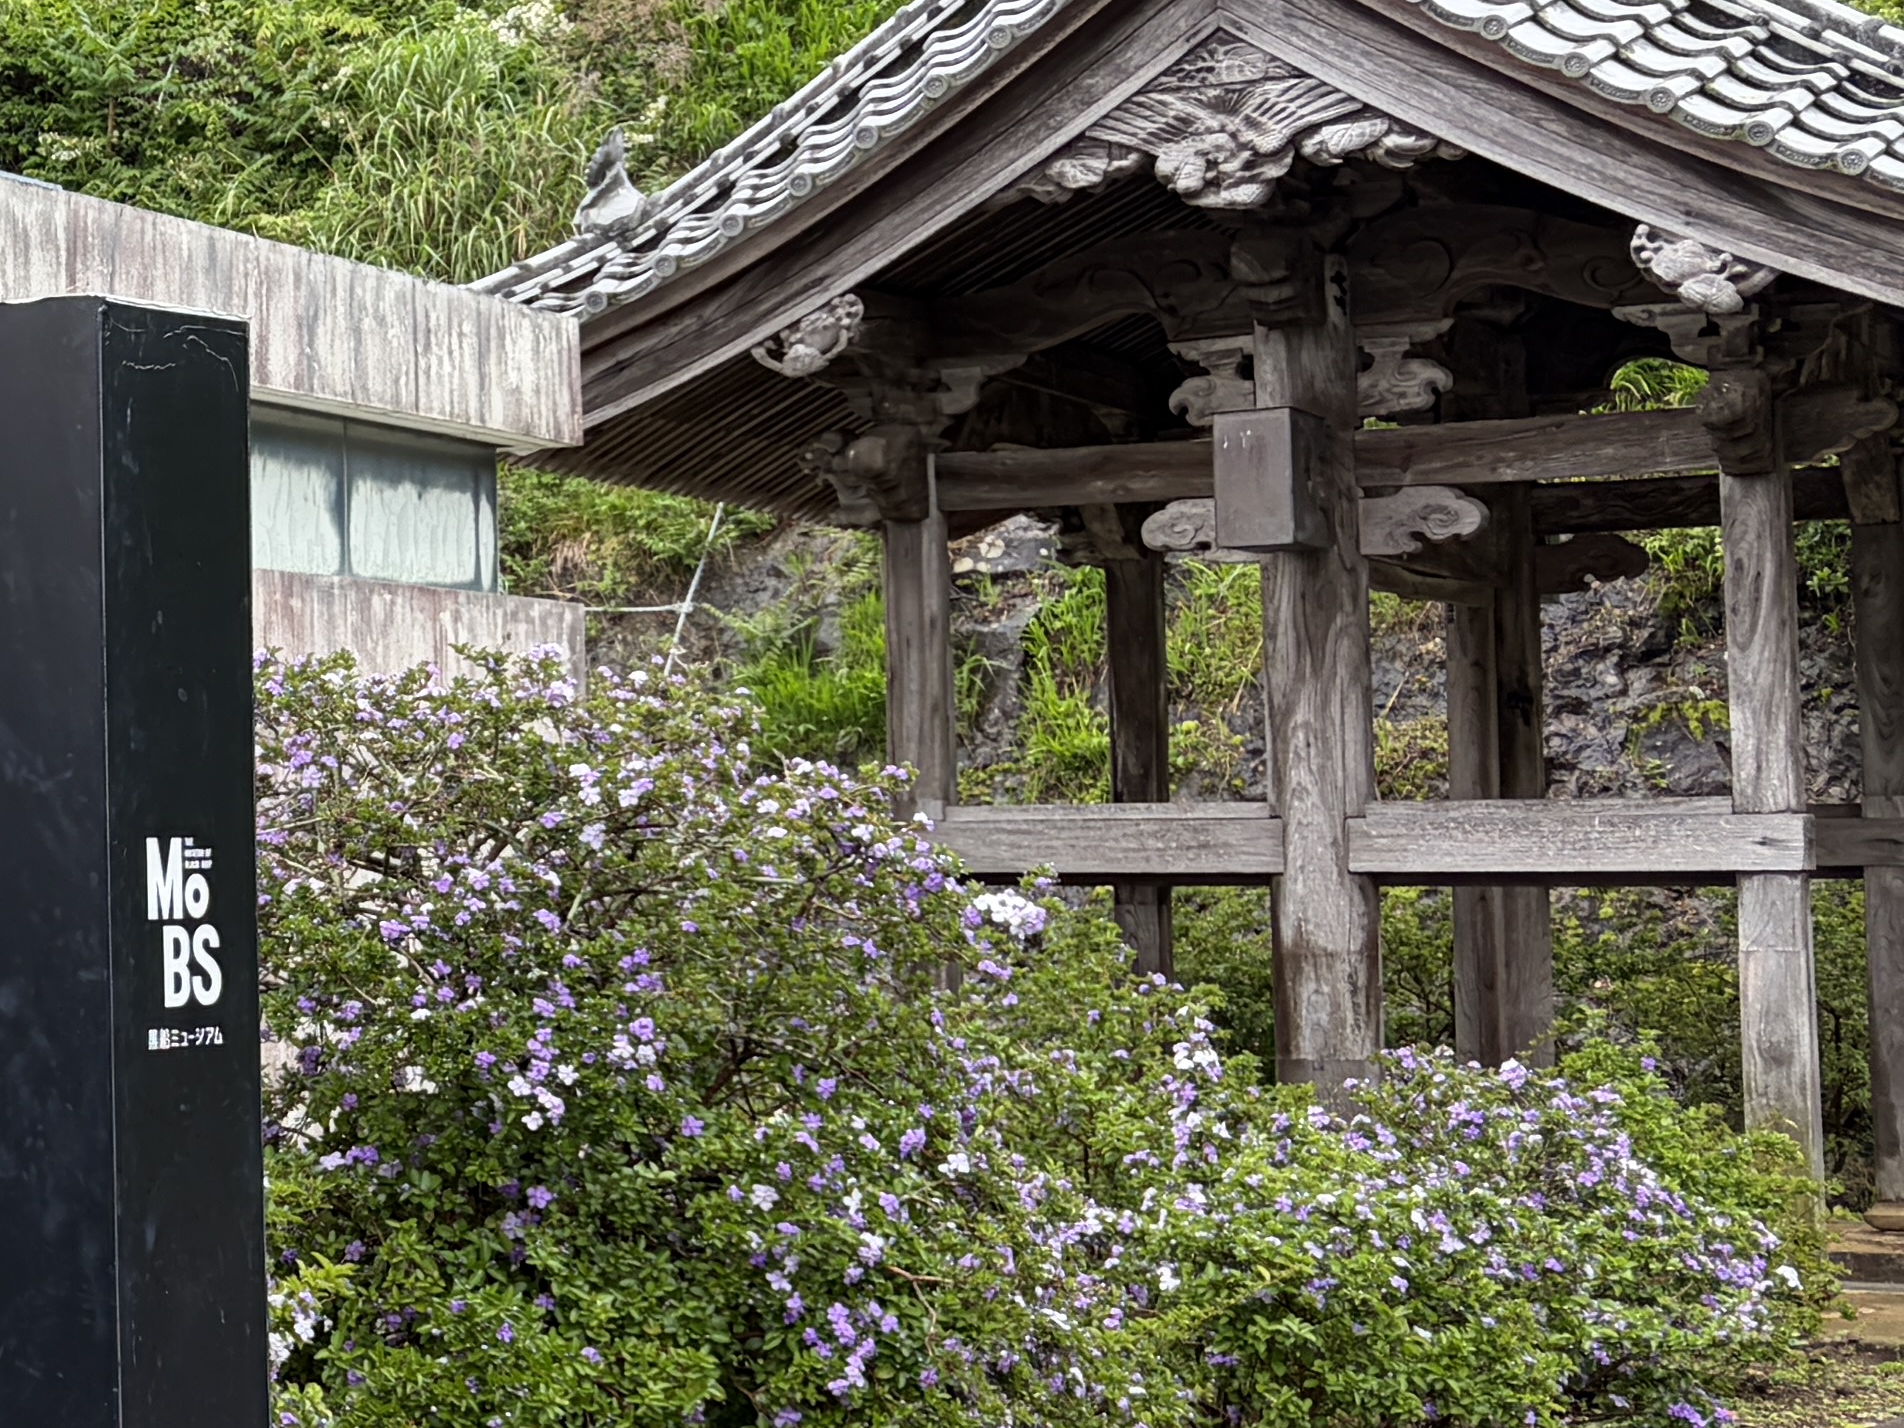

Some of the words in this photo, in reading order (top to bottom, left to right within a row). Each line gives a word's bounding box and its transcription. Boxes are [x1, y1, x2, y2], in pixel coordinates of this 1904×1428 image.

[145, 837, 210, 920] Mo
[162, 923, 222, 1008] BS
[148, 1026, 224, 1051] 黒船ミュージアム
